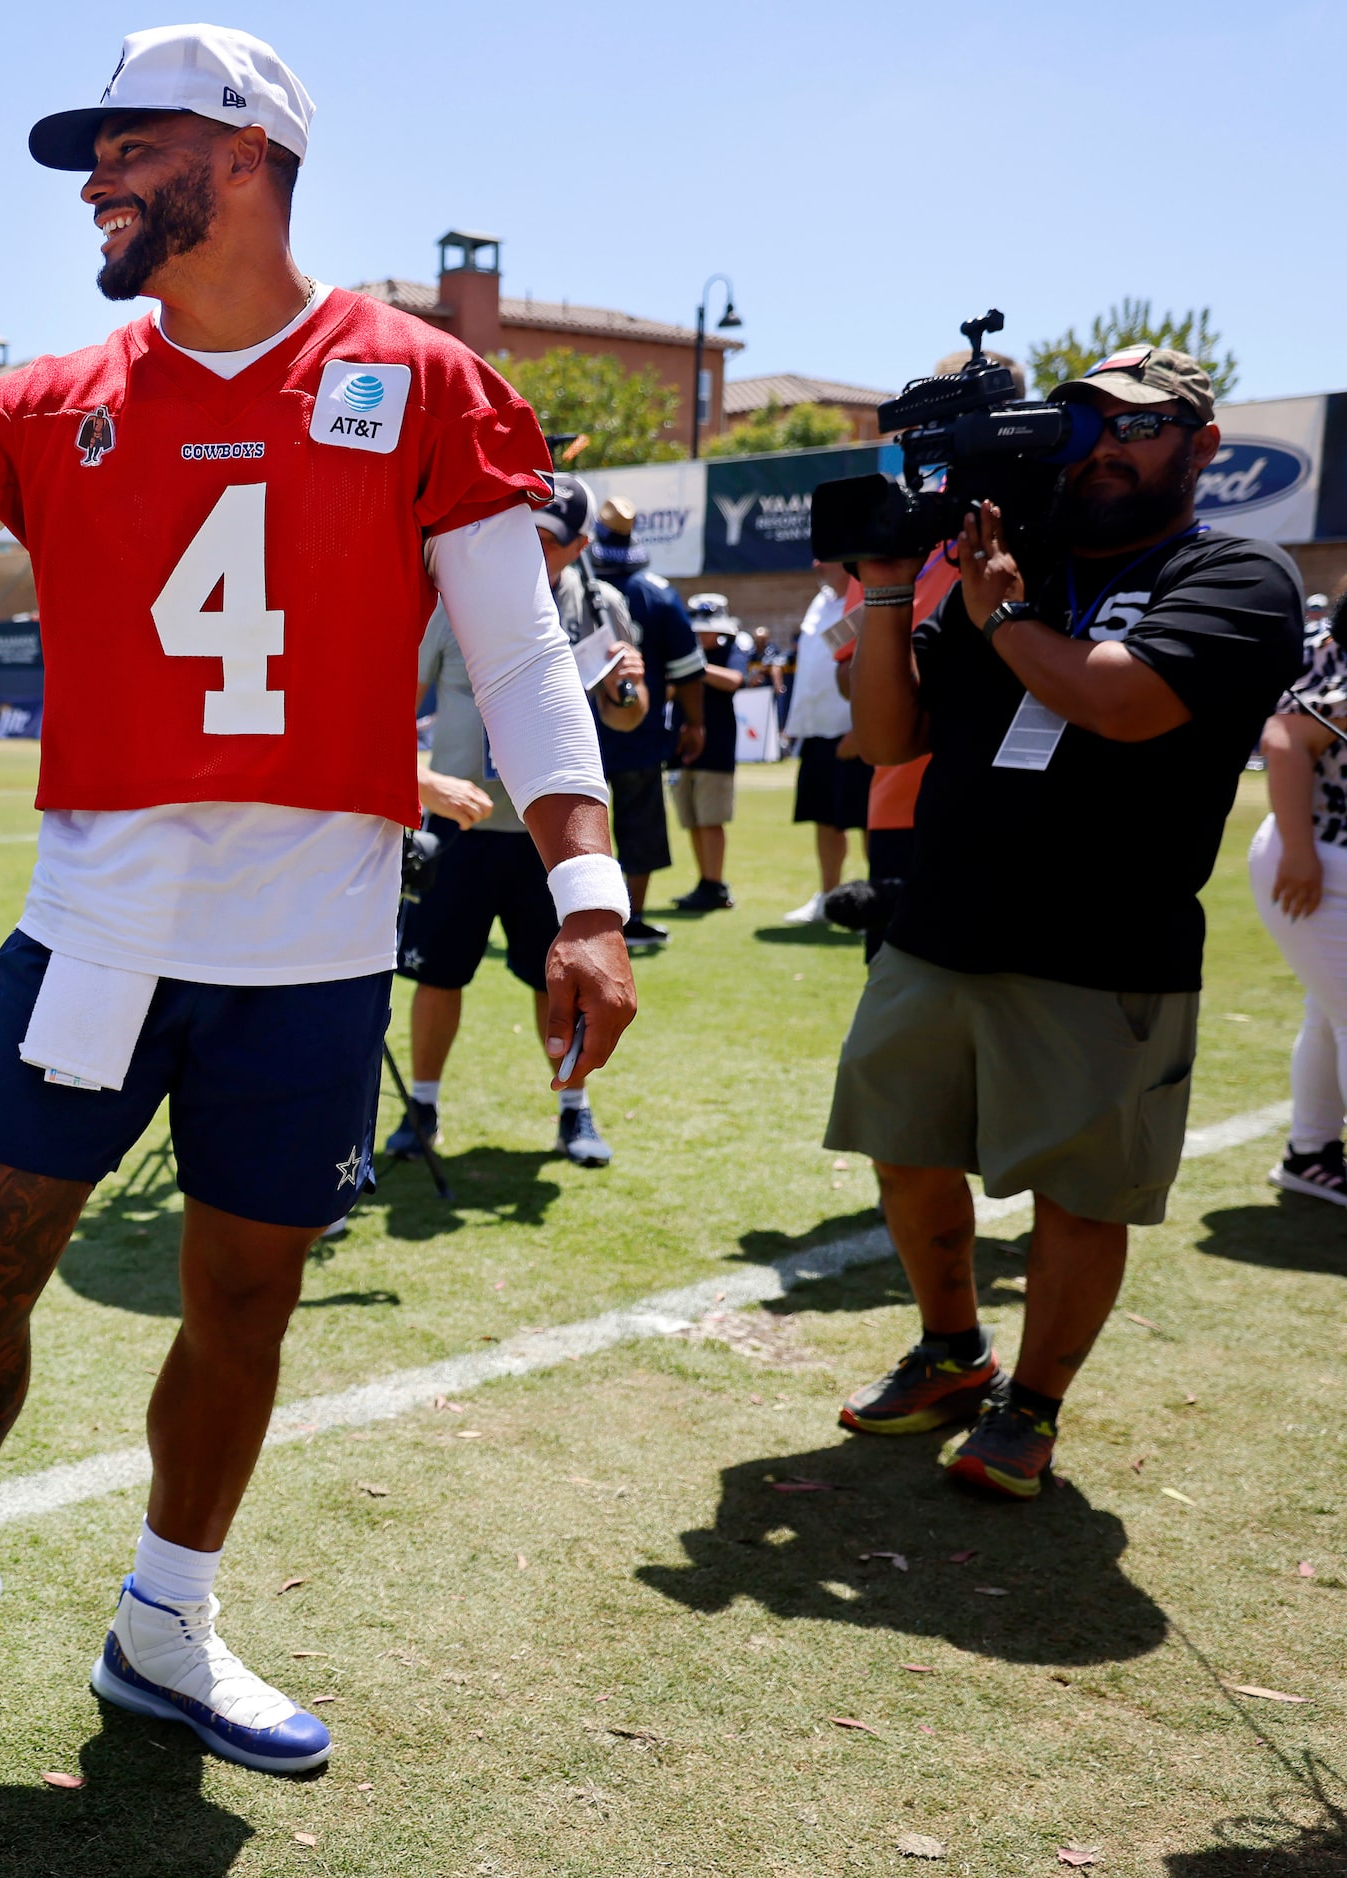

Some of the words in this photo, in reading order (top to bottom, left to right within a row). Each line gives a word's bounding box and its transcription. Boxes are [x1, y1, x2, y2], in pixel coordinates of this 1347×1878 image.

[329, 416, 383, 439] AT&T
[181, 441, 265, 460] COWBOYS
[150, 482, 285, 735] 4
